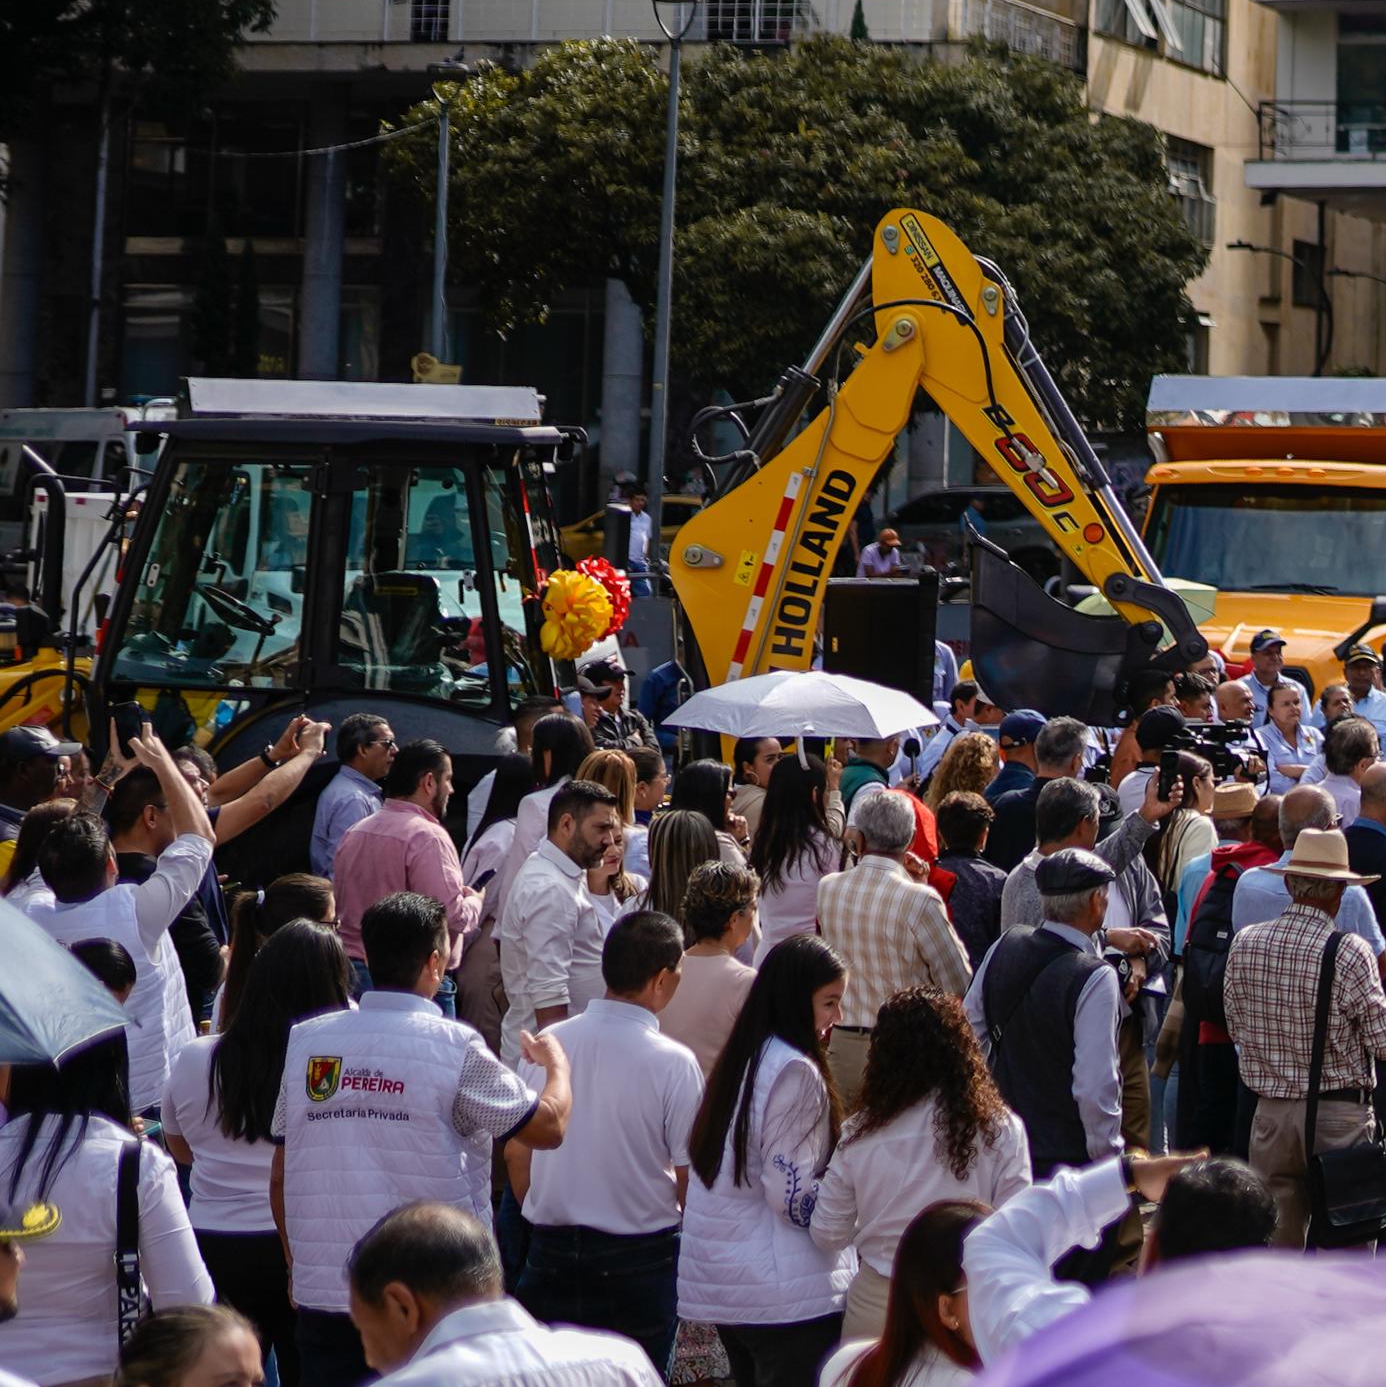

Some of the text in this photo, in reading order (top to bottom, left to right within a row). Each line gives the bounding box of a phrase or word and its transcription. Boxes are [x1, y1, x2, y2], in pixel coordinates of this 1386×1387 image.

[772, 469, 857, 657] HOLLAND
[340, 1076, 405, 1094] PEREIRA
[368, 1108, 410, 1122] Privada
